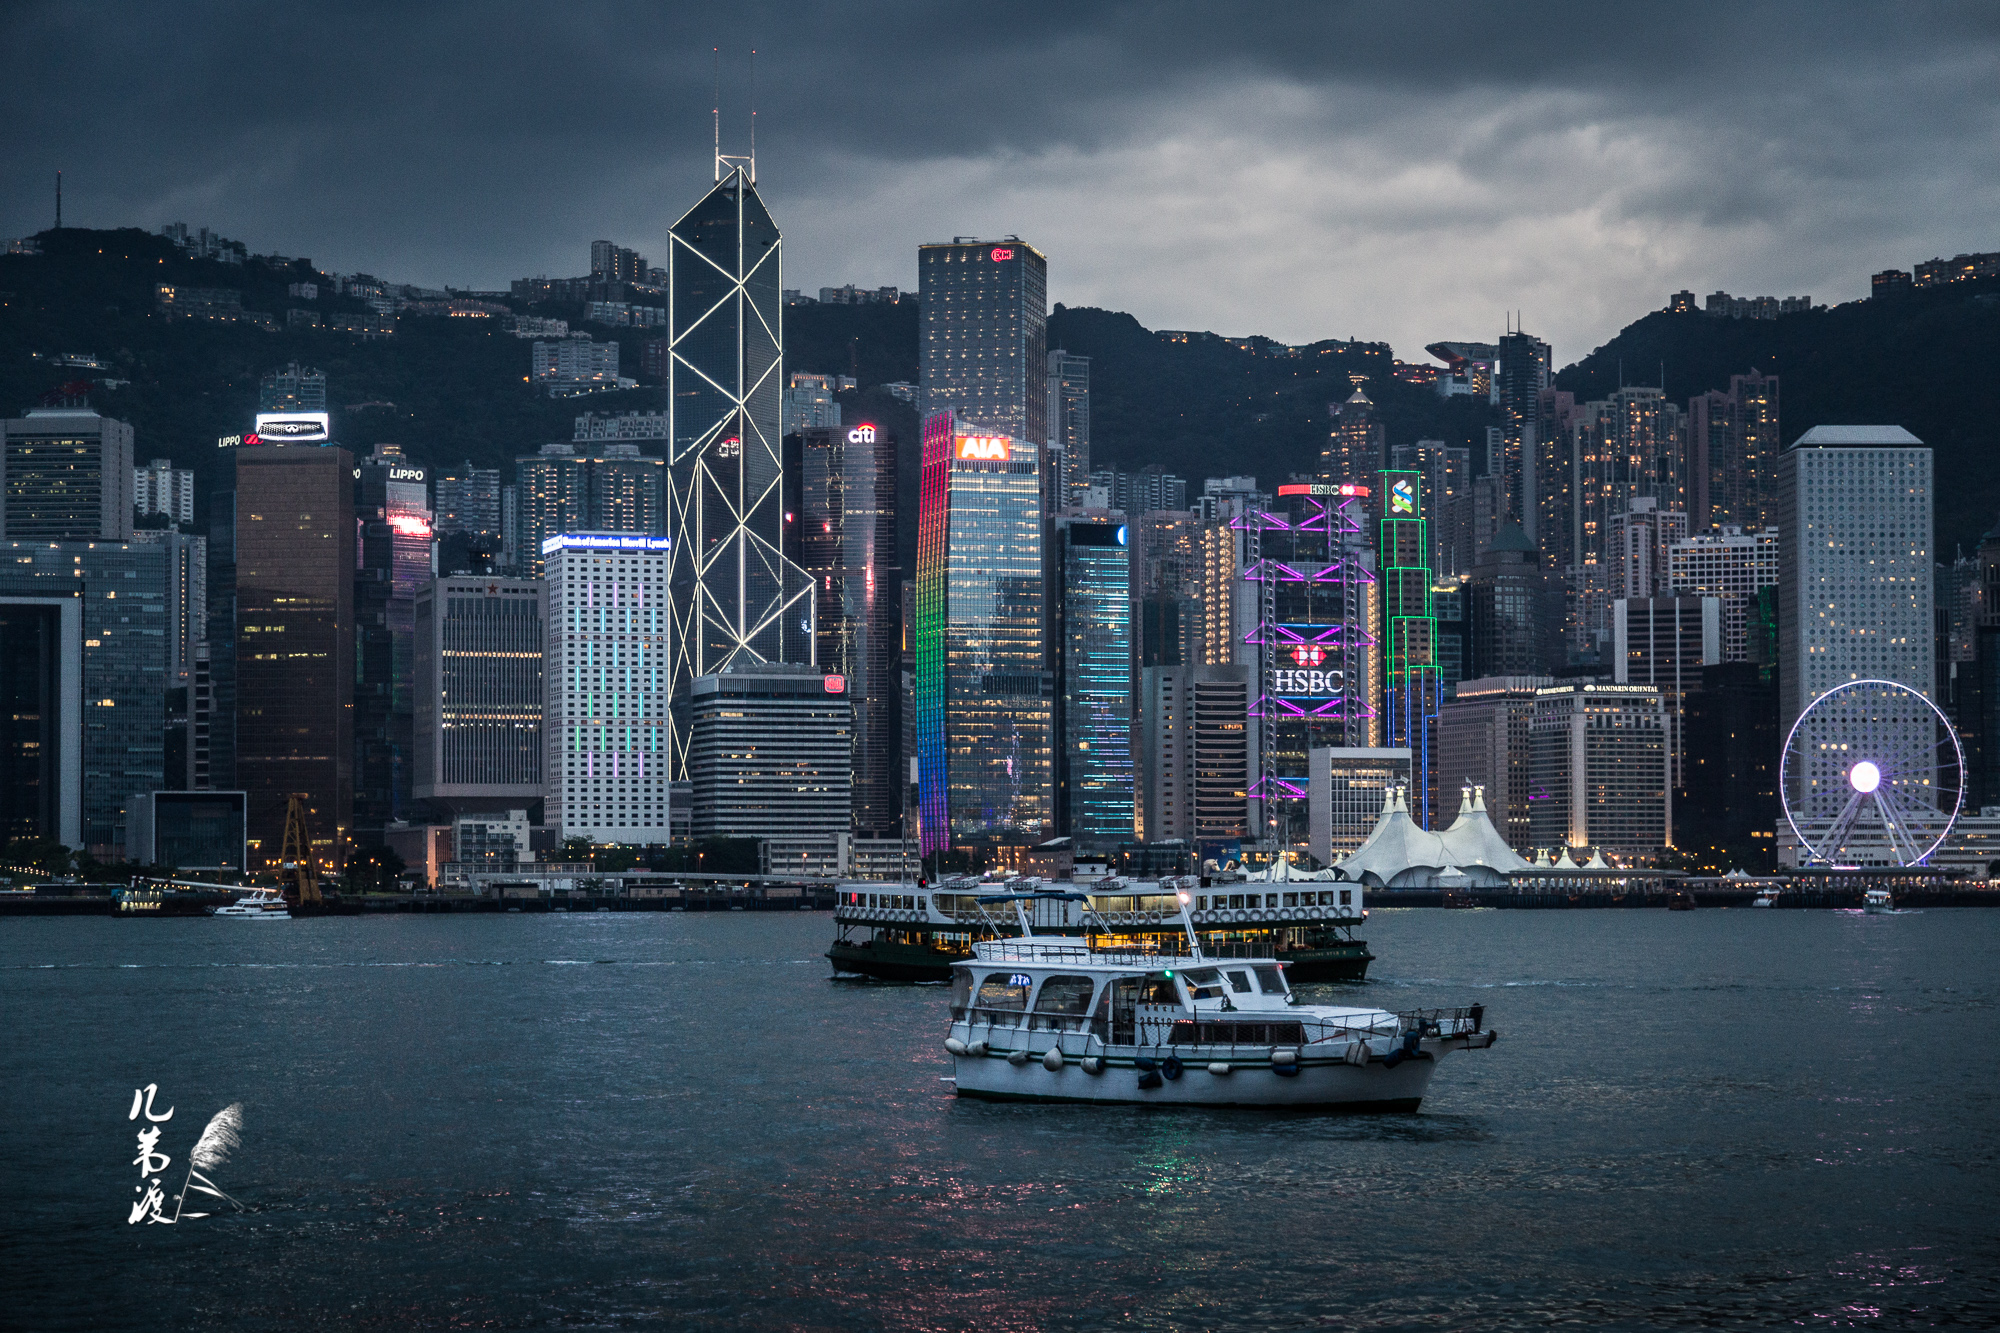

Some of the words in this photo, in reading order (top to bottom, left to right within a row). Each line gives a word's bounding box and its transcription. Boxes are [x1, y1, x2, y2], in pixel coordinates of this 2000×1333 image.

[218, 435, 241, 448] LIPPO
[848, 426, 875, 444] citi
[962, 438, 1005, 458] AIA
[389, 468, 424, 481] LIPPO
[1310, 484, 1339, 496] HSBC
[563, 536, 582, 546] Bank
[582, 537, 590, 546] of
[590, 537, 620, 547] America
[621, 538, 646, 547] Merrill
[647, 538, 669, 549] Lynch
[1275, 670, 1344, 693] HSBC
[1140, 1016, 1172, 1027] 26510
